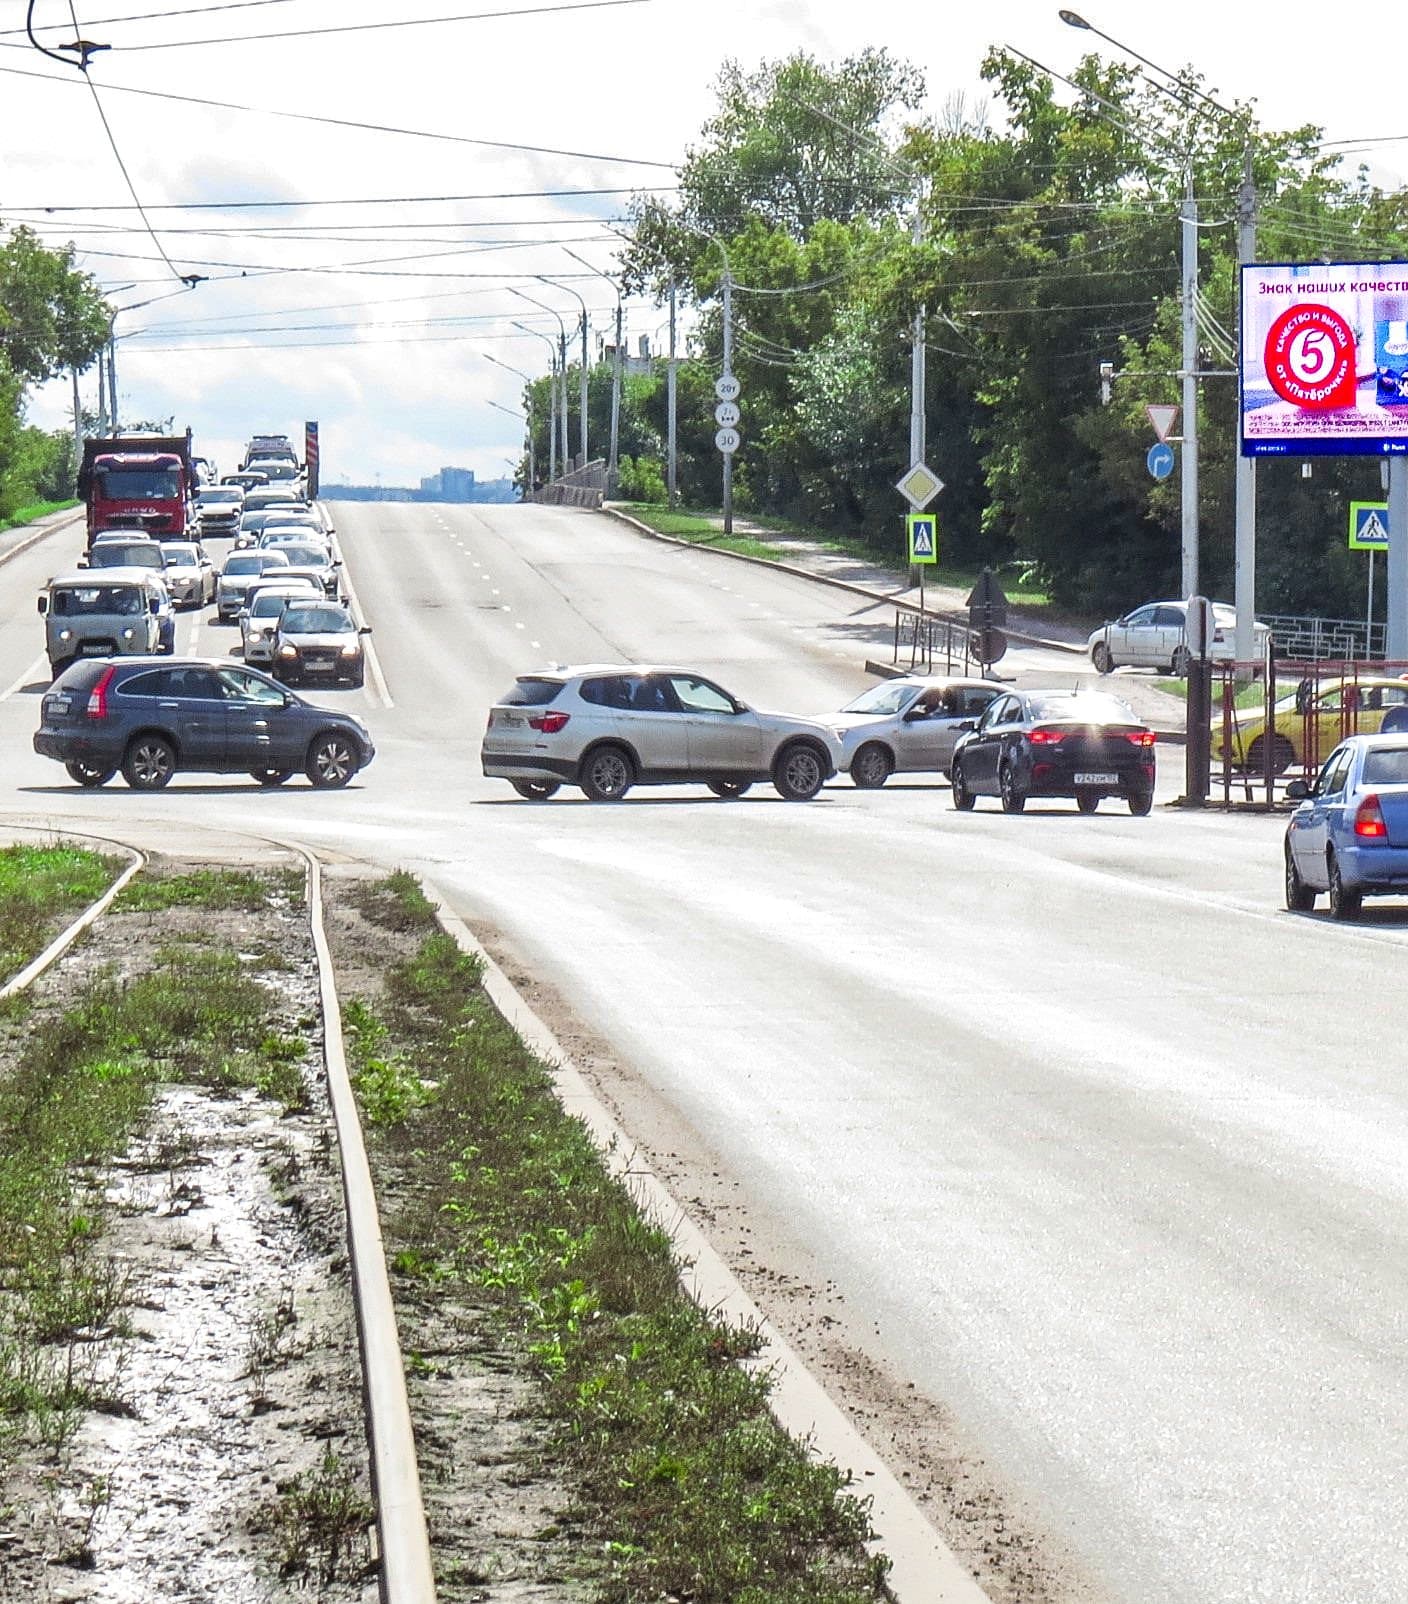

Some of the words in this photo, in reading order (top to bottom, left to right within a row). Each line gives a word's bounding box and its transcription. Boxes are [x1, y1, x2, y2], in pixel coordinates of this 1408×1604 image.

[1258, 282, 1293, 294] Знак
[1297, 282, 1346, 293] наших
[1276, 312, 1310, 353] КАЧЕСТВО
[1312, 312, 1320, 320] И
[1320, 313, 1348, 349] ВЫГОДА
[1301, 330, 1326, 374] 5
